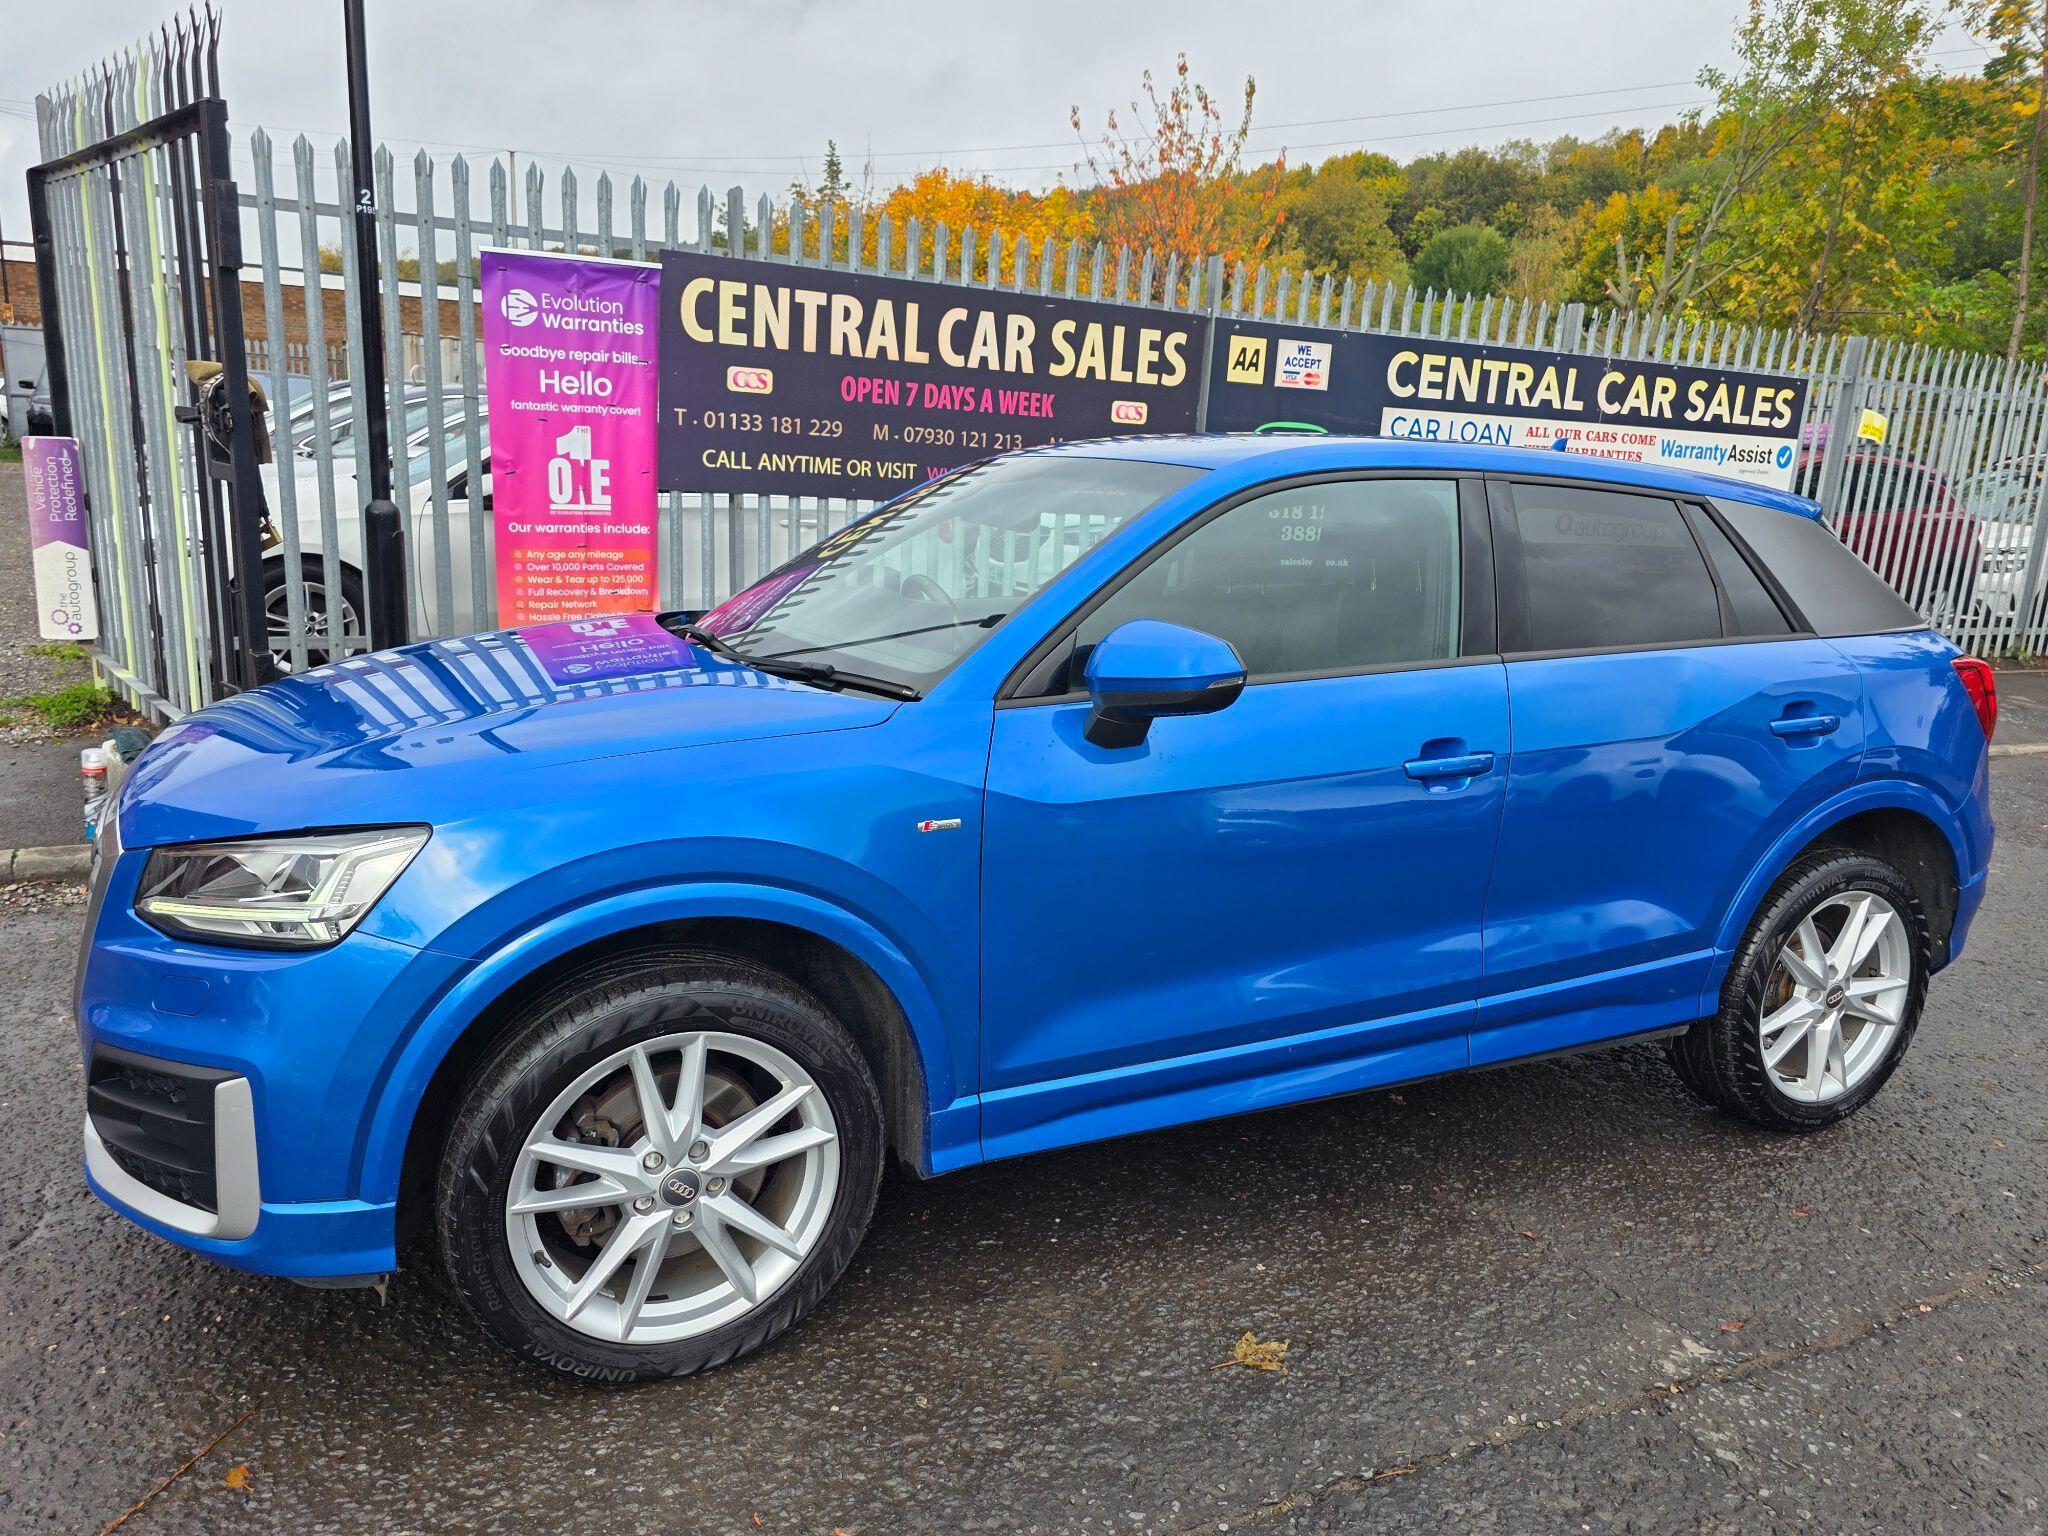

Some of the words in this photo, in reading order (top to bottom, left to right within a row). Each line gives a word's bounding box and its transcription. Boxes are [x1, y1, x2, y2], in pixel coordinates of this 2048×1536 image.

[360, 189, 371, 204] 2
[542, 293, 623, 315] Evolution
[542, 313, 644, 335] Warranties
[680, 277, 930, 365] CENTRAL
[937, 307, 1036, 374] CAR
[1048, 319, 1187, 387] SALES
[500, 344, 566, 362] Goodbye
[569, 350, 610, 365] repair
[1232, 347, 1260, 372] AA
[1297, 345, 1312, 356] WE
[1285, 356, 1322, 369] ACCEPT
[540, 370, 612, 396] Hello
[733, 370, 768, 390] CCS
[1386, 350, 1583, 411] CENTRAL
[1597, 371, 1677, 419] CAR
[1684, 379, 1795, 429] SALES
[841, 375, 899, 406] OPEN
[906, 382, 919, 407] 7
[924, 383, 975, 412] DAYS
[980, 388, 993, 414] A
[998, 389, 1055, 418] WEEK
[511, 400, 559, 412] fantastic
[561, 402, 608, 417] warranty
[704, 411, 762, 432] 01133
[771, 417, 801, 435] 181
[808, 419, 843, 437] 229
[904, 427, 955, 446] 07930
[961, 431, 987, 448] 121
[994, 433, 1022, 450] 213
[1390, 416, 1440, 439] CAR
[1449, 420, 1512, 446] LOAN
[1525, 426, 1550, 438] ALL
[1554, 428, 1582, 441] OUR
[1586, 430, 1618, 443] CARS
[1621, 433, 1657, 446] COME
[702, 449, 752, 470] CALL
[757, 452, 842, 476] ANYTIME
[847, 459, 872, 477] OR
[876, 461, 917, 480] VISIT
[35, 466, 47, 511] Vehicle
[46, 456, 62, 522] Protection
[60, 455, 79, 521] Redefined
[508, 522, 531, 533] Our
[535, 523, 600, 534] warranties
[604, 523, 651, 535] include:
[1574, 519, 1665, 542] autogroup
[526, 550, 544, 560] Any
[547, 551, 566, 561] age
[567, 551, 586, 561] any
[587, 550, 624, 561] mileage
[526, 563, 550, 571] Over
[552, 563, 580, 572] 10,000
[582, 563, 604, 571] Parts
[606, 563, 644, 571] Covered
[65, 551, 82, 621] autogroup
[528, 576, 553, 584] Wear
[555, 576, 563, 584] &
[565, 576, 586, 584] Tear
[587, 576, 599, 585] up
[600, 576, 609, 584] to
[611, 575, 644, 584] 125,000
[528, 588, 544, 596] Full
[546, 588, 588, 598] Recovery
[590, 588, 597, 596] &
[599, 588, 649, 596] Breakdown
[528, 601, 559, 610] Repair
[561, 600, 598, 609] Network
[529, 613, 560, 622] Hassle
[562, 613, 583, 621] Free
